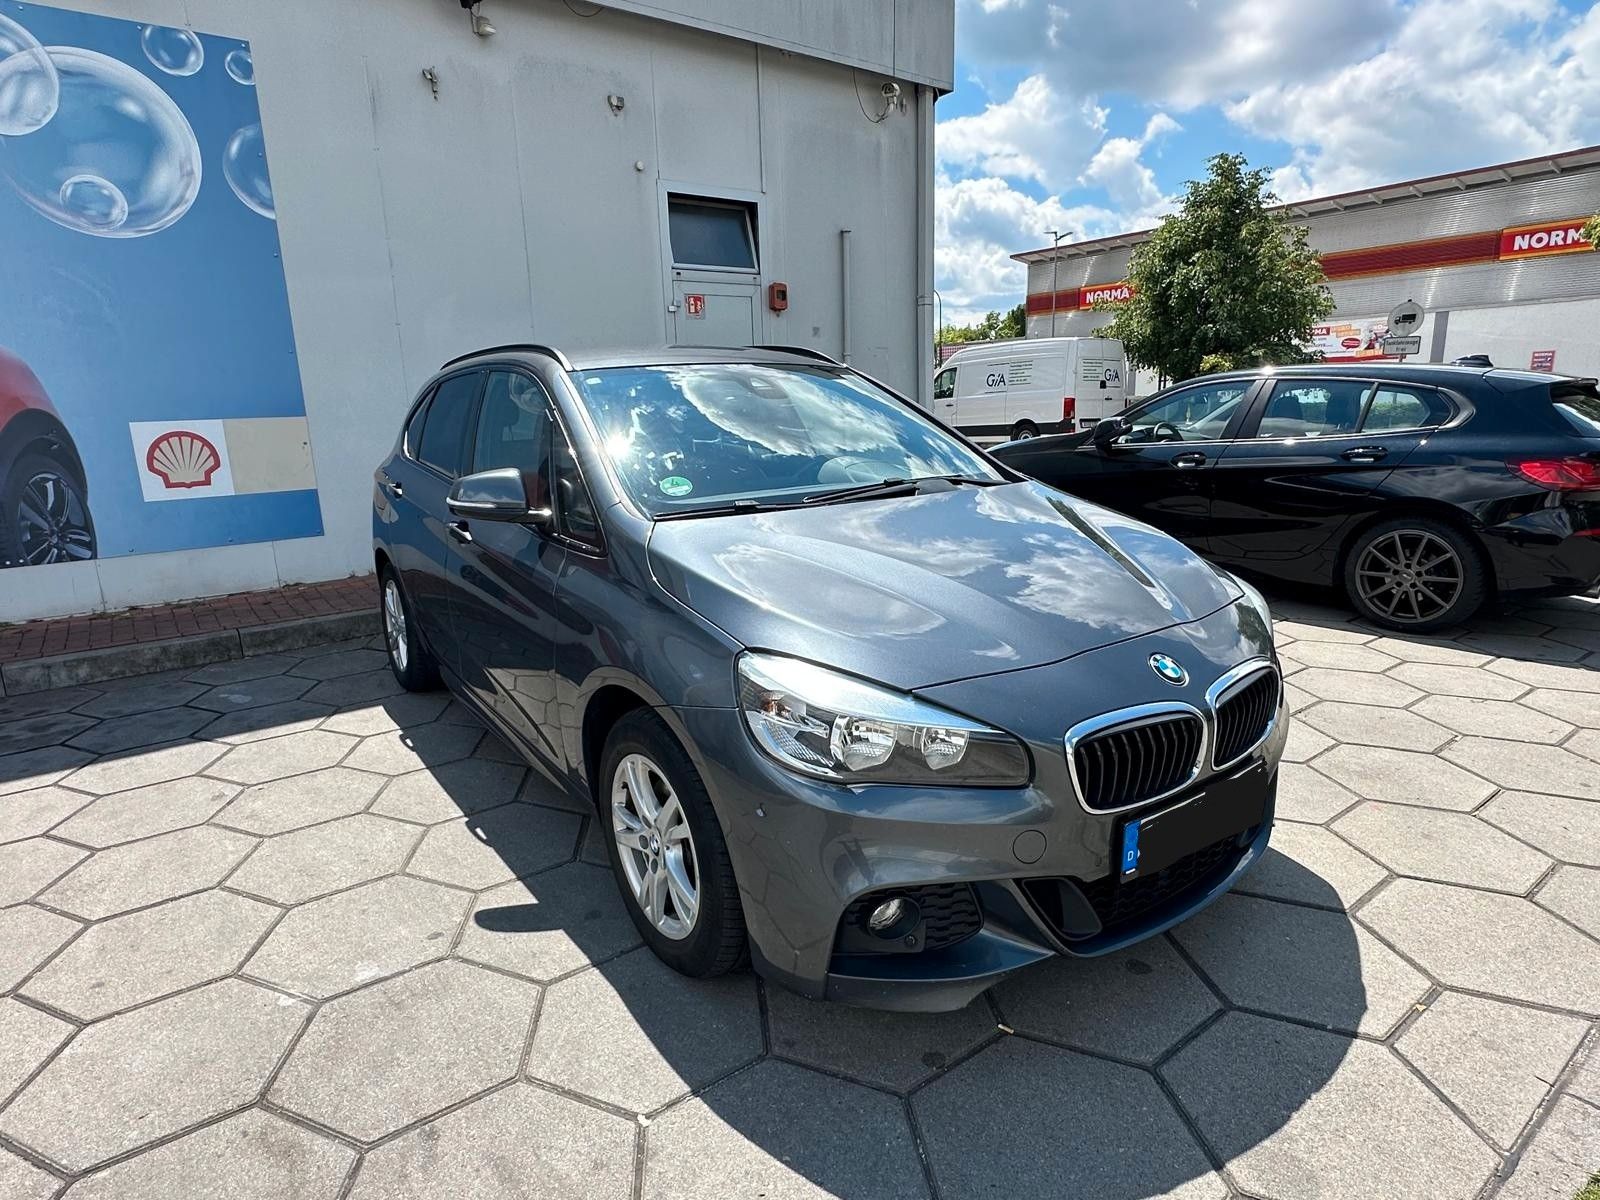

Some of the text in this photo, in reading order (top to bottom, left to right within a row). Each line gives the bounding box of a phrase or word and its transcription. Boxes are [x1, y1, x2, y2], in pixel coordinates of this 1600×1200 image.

[1513, 228, 1590, 251] NORM
[1086, 287, 1130, 304] NORMA
[1127, 850, 1134, 861] D
